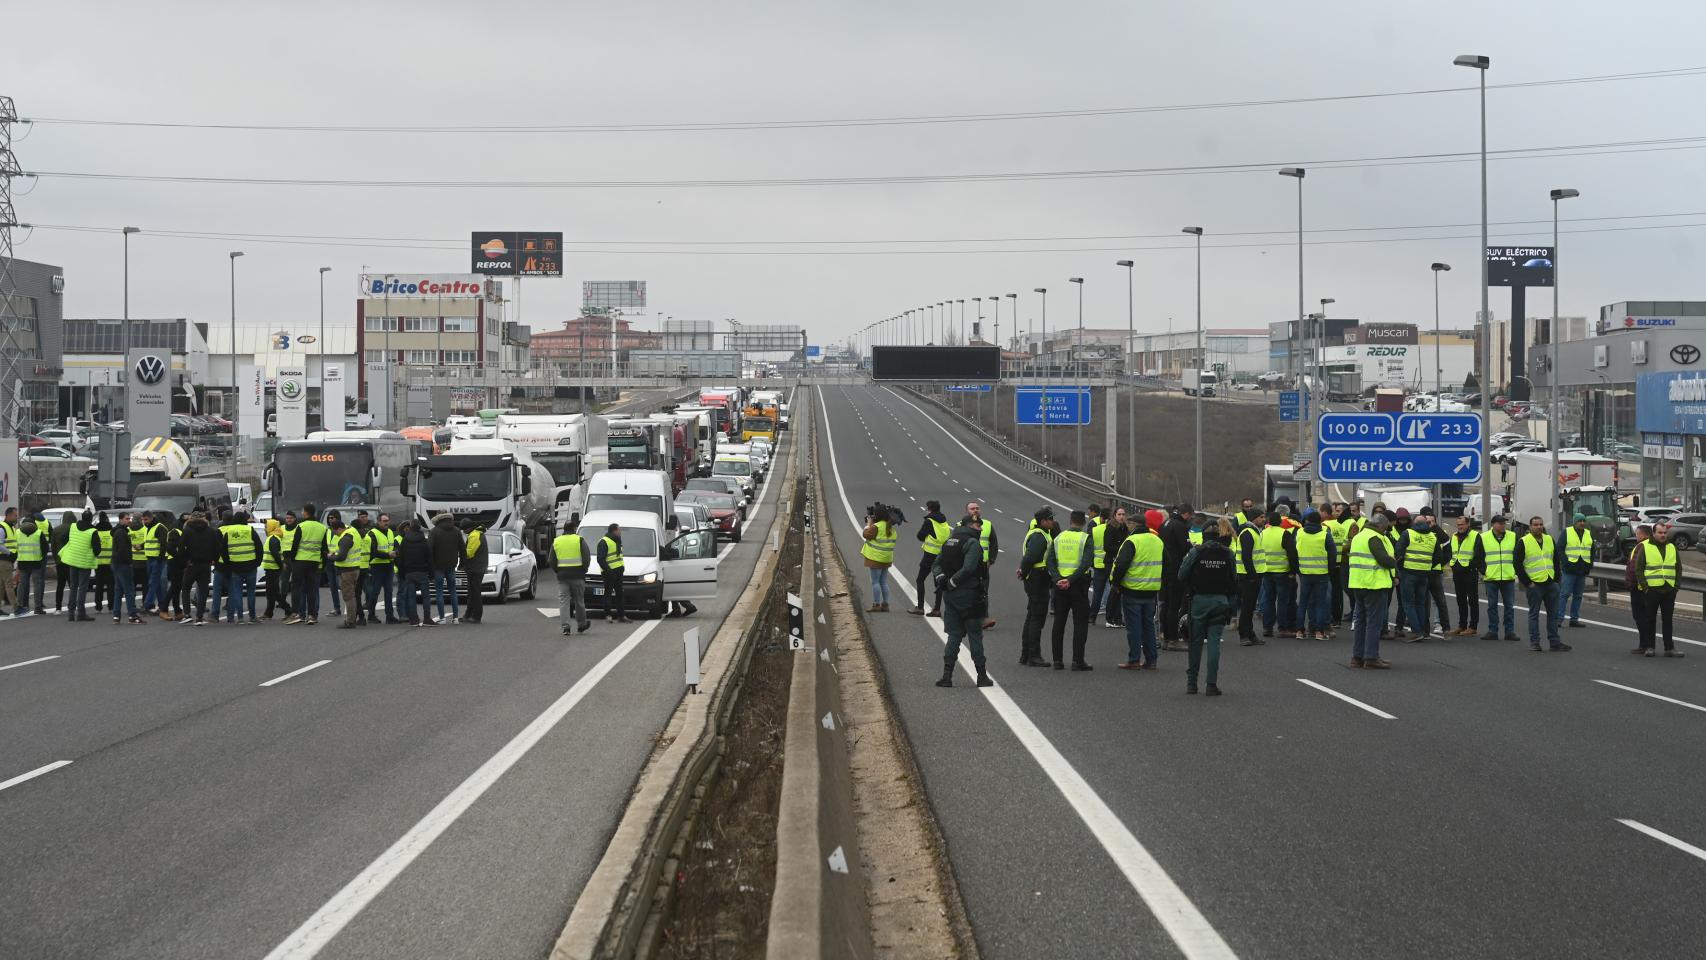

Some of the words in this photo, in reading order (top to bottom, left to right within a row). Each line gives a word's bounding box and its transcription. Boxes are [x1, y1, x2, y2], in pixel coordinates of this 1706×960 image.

[476, 261, 512, 269] REPSOL
[539, 262, 556, 270] 233
[371, 279, 480, 294] BricoCentro
[1368, 327, 1409, 338] Muscari
[1366, 347, 1407, 357] REDUR
[1328, 423, 1369, 435] 1000
[1374, 426, 1385, 435] m
[1440, 423, 1473, 435] 233
[311, 454, 334, 462] alsa
[1328, 458, 1414, 472] Villariezo
[793, 638, 799, 648] 6
